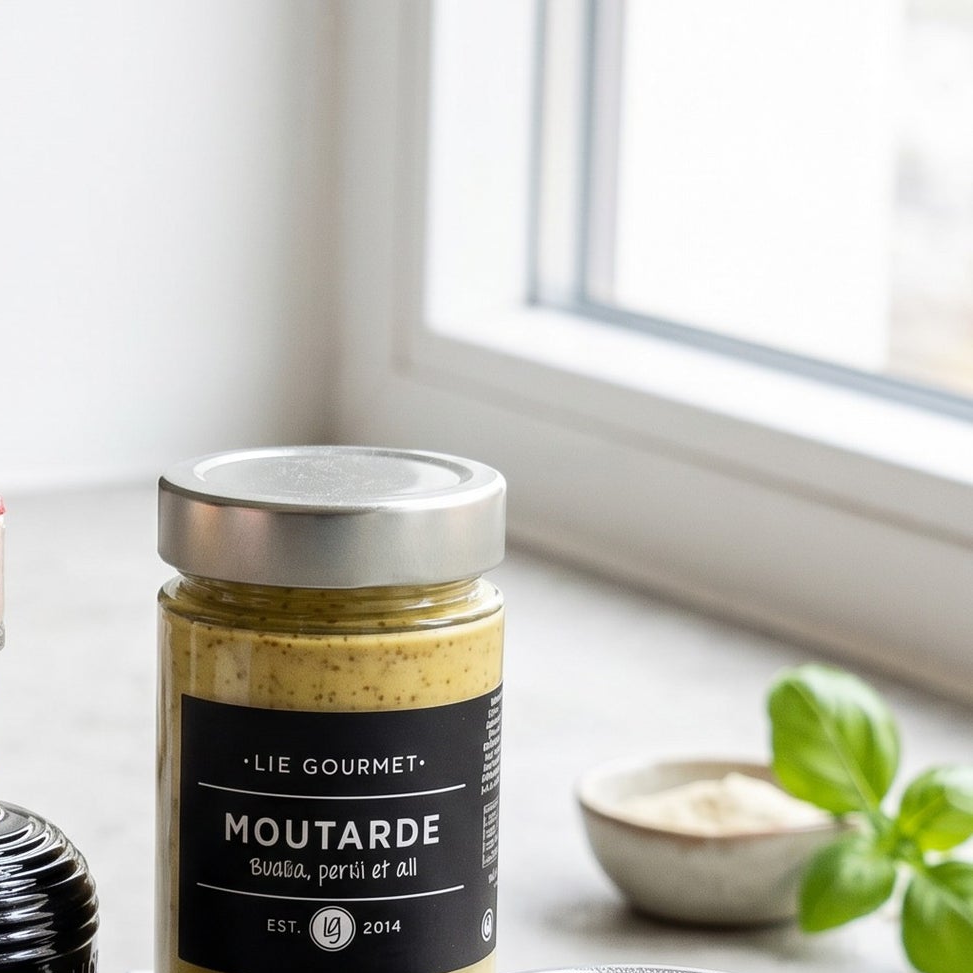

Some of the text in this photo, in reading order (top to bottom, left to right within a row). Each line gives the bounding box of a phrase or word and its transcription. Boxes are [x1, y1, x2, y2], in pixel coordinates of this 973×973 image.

[224, 812, 440, 851] MOUTARDE
[371, 859, 391, 879] et
[396, 856, 417, 878] all
[266, 919, 301, 934] EST.
[363, 919, 402, 935] 2014
